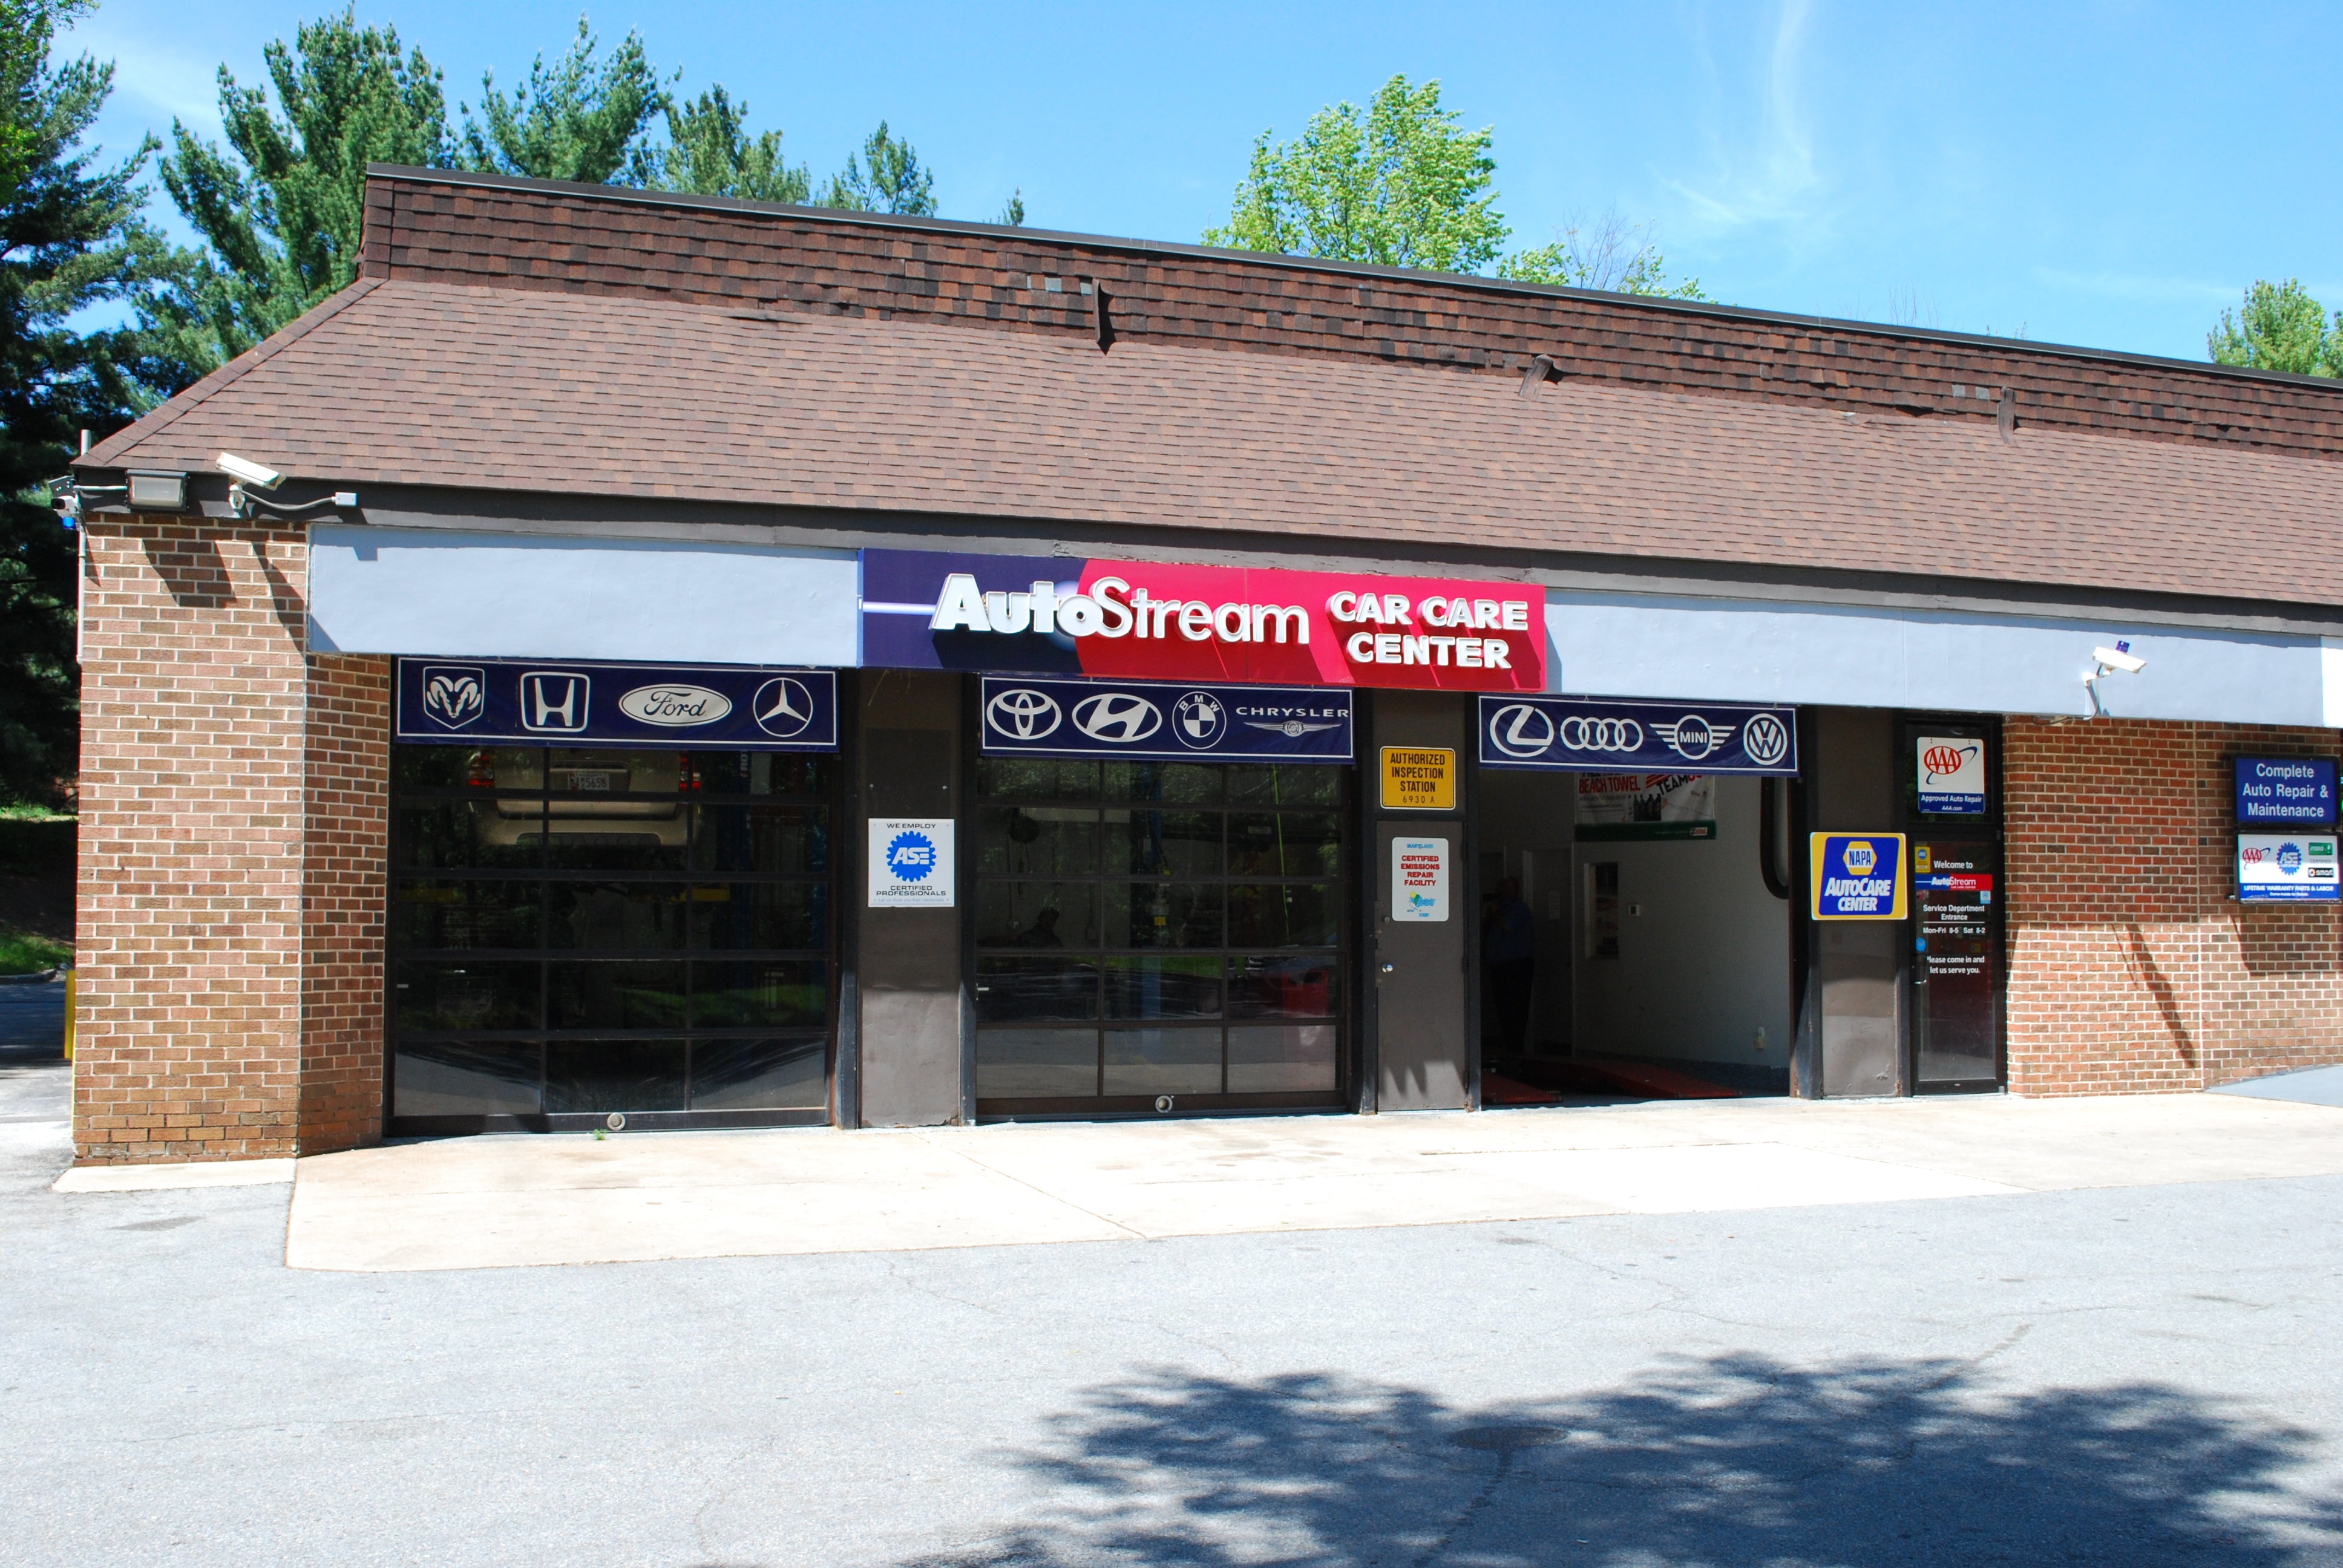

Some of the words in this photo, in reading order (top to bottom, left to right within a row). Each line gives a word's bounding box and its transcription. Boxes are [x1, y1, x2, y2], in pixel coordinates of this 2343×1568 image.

[930, 572, 1311, 645] AutoStream
[1329, 590, 1412, 626] CAR
[1420, 595, 1529, 632] CARE
[1347, 632, 1512, 670] CENTER
[643, 690, 707, 718] Ford
[1236, 706, 1350, 718] CHRYSLER
[1679, 730, 1708, 744] MINI
[1390, 753, 1445, 765] AUTHORIZED
[1925, 746, 1960, 774] AAA
[1391, 766, 1444, 779] INSPECTION
[2256, 763, 2314, 779] Complete
[1400, 780, 1435, 792] STATION
[1579, 777, 1607, 794] BEACH
[1608, 775, 1640, 792] TOWEL
[2243, 783, 2271, 797] Auto
[2276, 783, 2315, 800] Repair
[2319, 785, 2328, 798] &
[1921, 794, 1948, 803] Approved
[2247, 802, 2324, 817] Maintenance
[891, 847, 930, 865] ASE
[1849, 851, 1871, 866] NAPA
[2243, 848, 2262, 864] AAA
[2279, 852, 2298, 864] ASE
[1933, 860, 1965, 869] Welcome
[1931, 877, 1976, 886] AutoStream
[1838, 897, 1878, 912] CENTER
